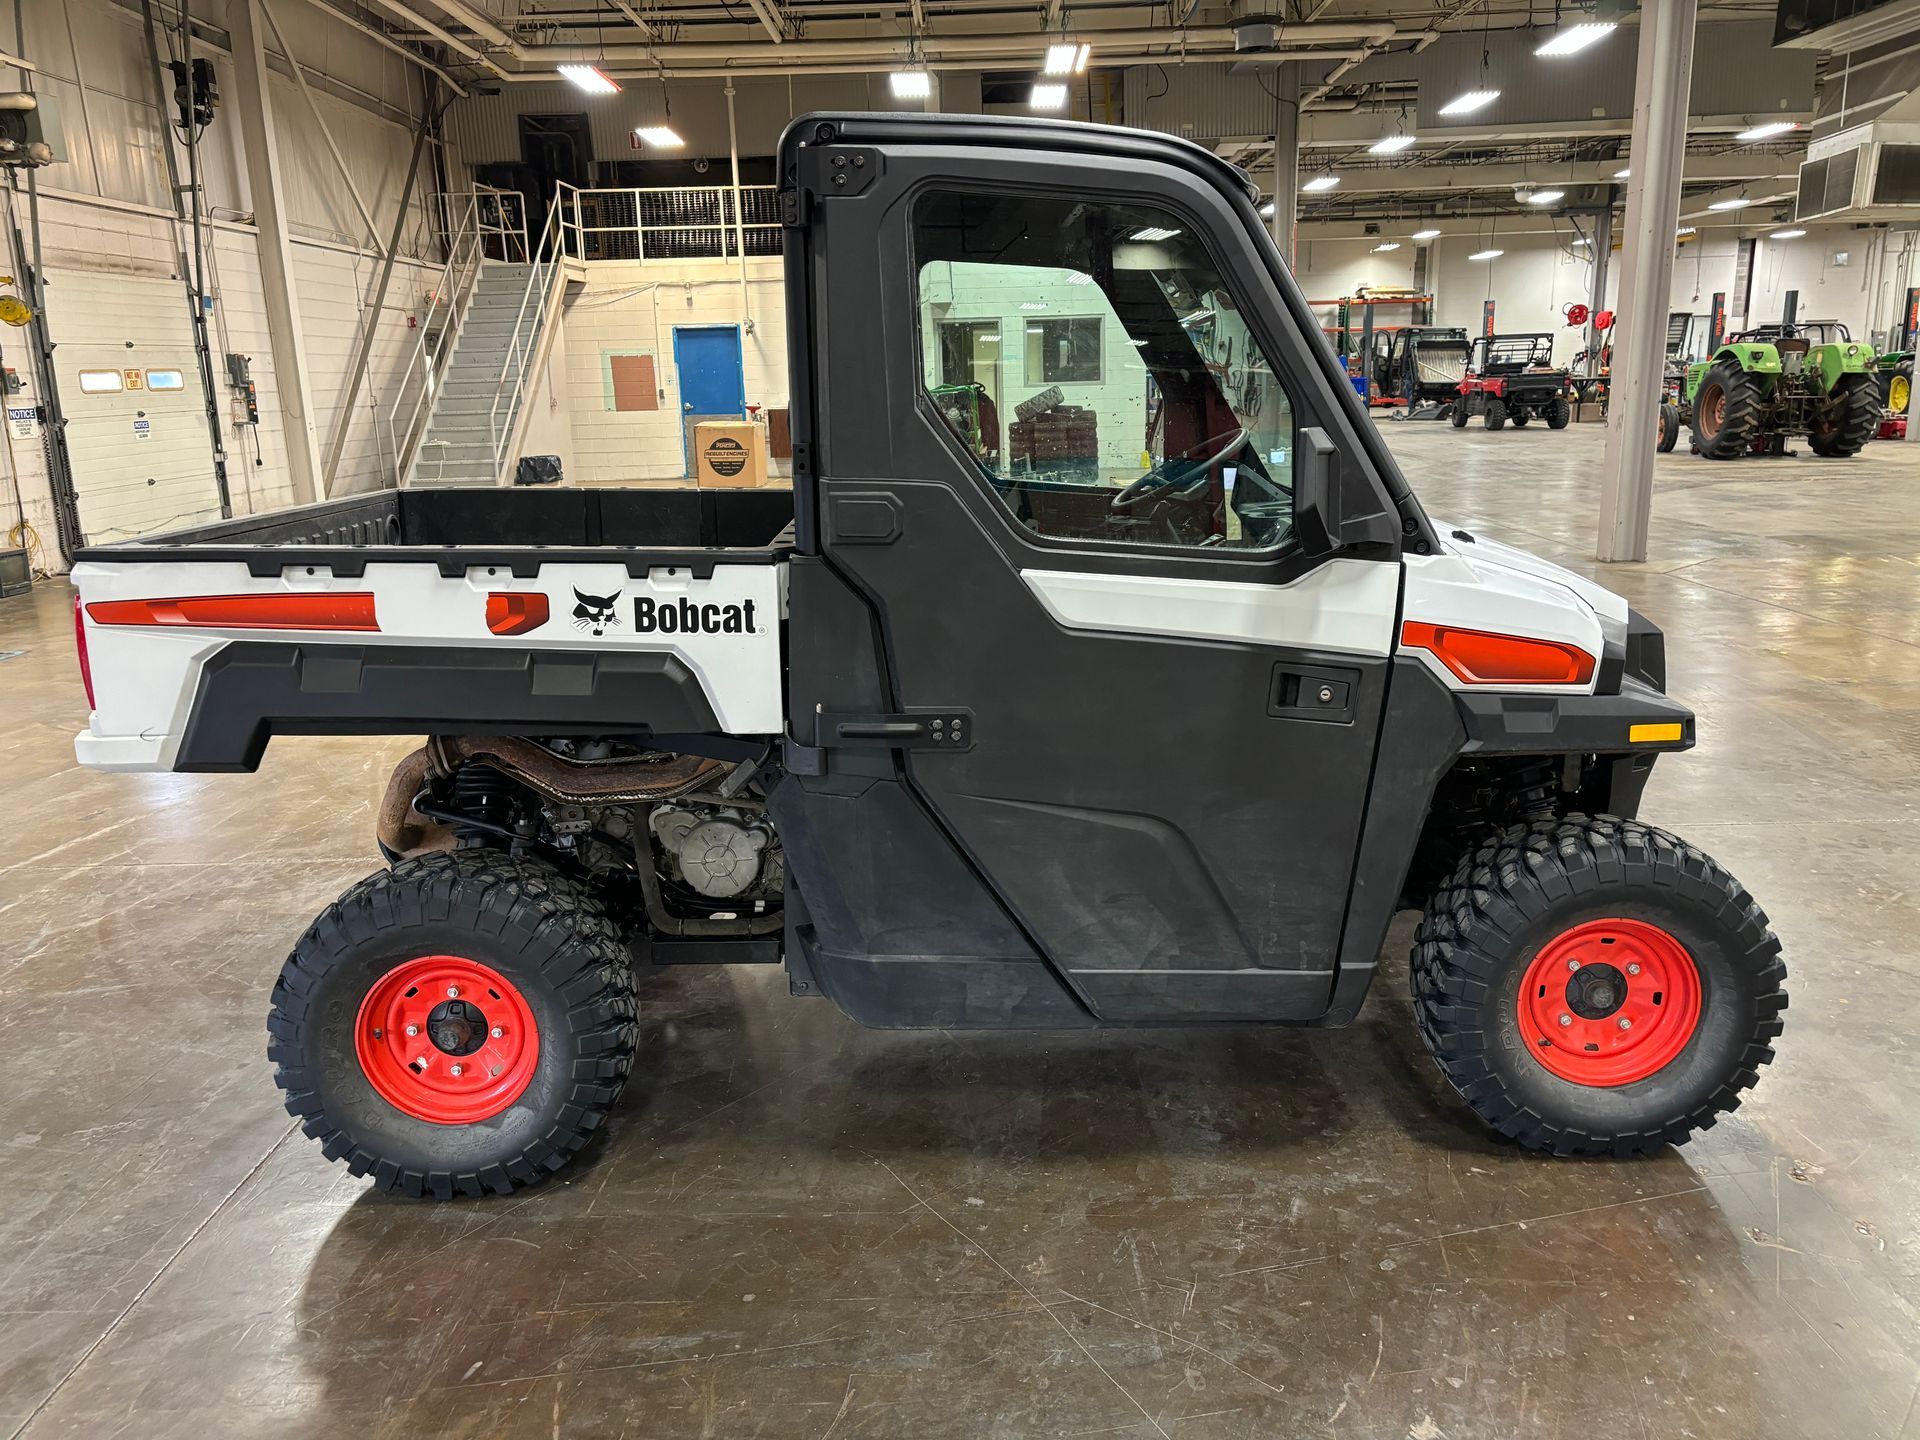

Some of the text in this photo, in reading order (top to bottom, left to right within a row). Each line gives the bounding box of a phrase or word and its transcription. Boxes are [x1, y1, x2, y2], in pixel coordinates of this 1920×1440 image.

[1715, 307, 1724, 336] STRATUS
[126, 371, 134, 379] NOT
[129, 379, 138, 388] EXIT
[9, 409, 35, 419] NOTICE
[134, 421, 149, 429] NOTICE
[634, 597, 756, 634] Bobcat
